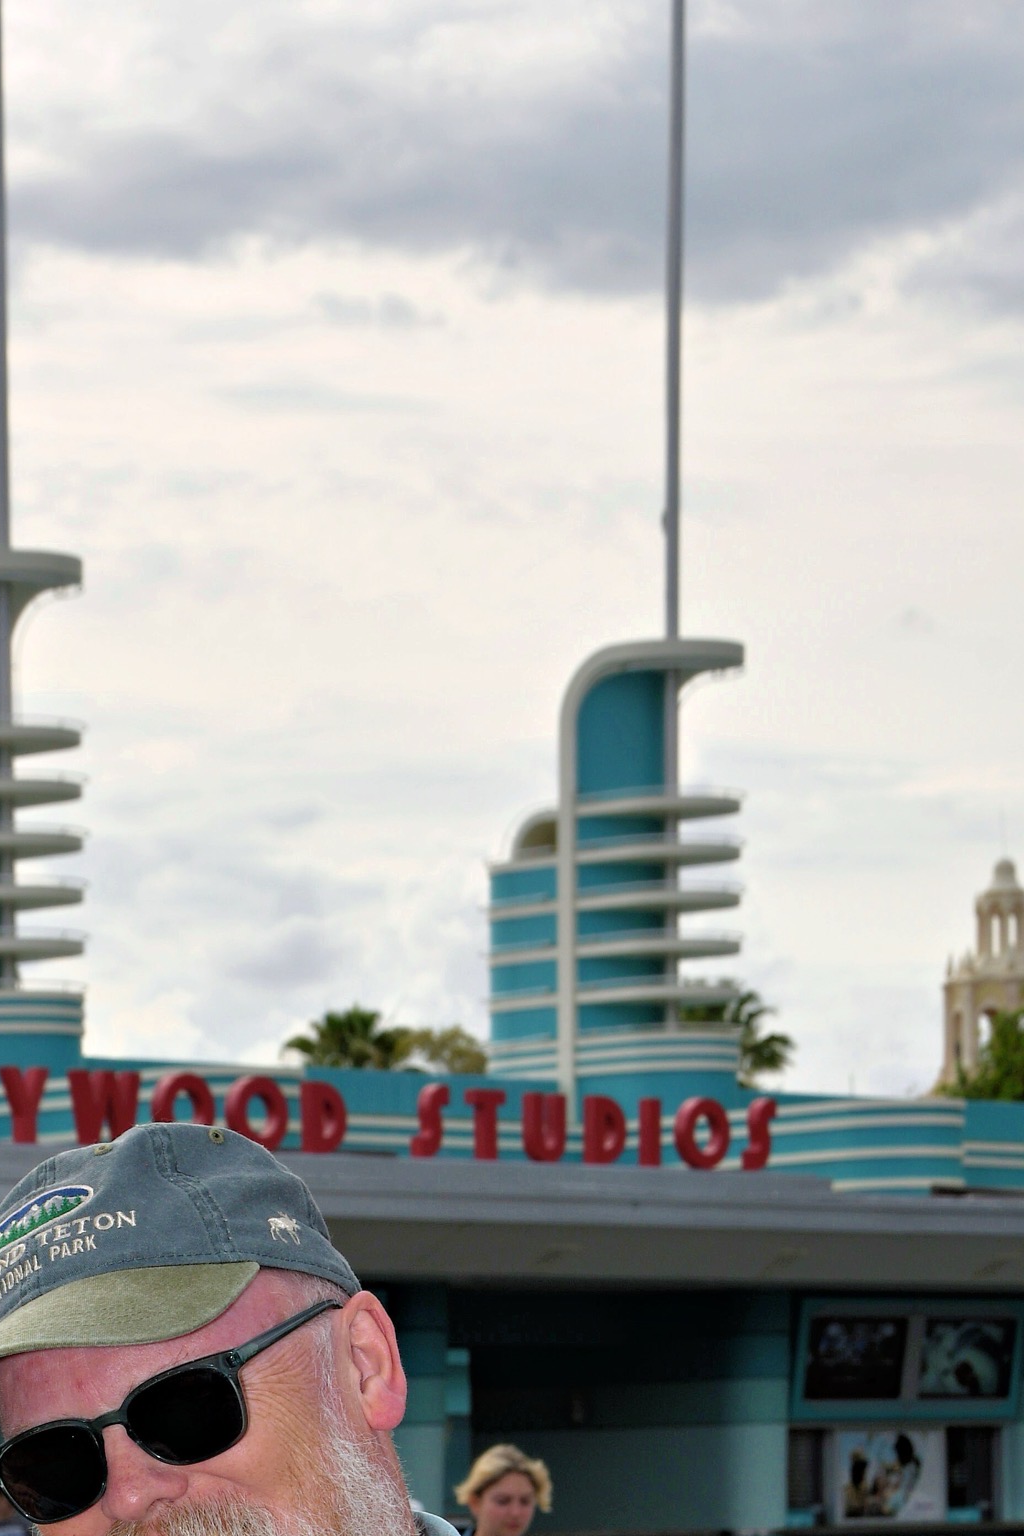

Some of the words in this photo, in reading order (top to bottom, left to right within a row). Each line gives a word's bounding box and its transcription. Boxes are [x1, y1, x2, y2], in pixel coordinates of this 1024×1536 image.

[409, 1083, 779, 1171] STUDIOS
[35, 1209, 136, 1247] TETON
[49, 1234, 97, 1261] PARK
